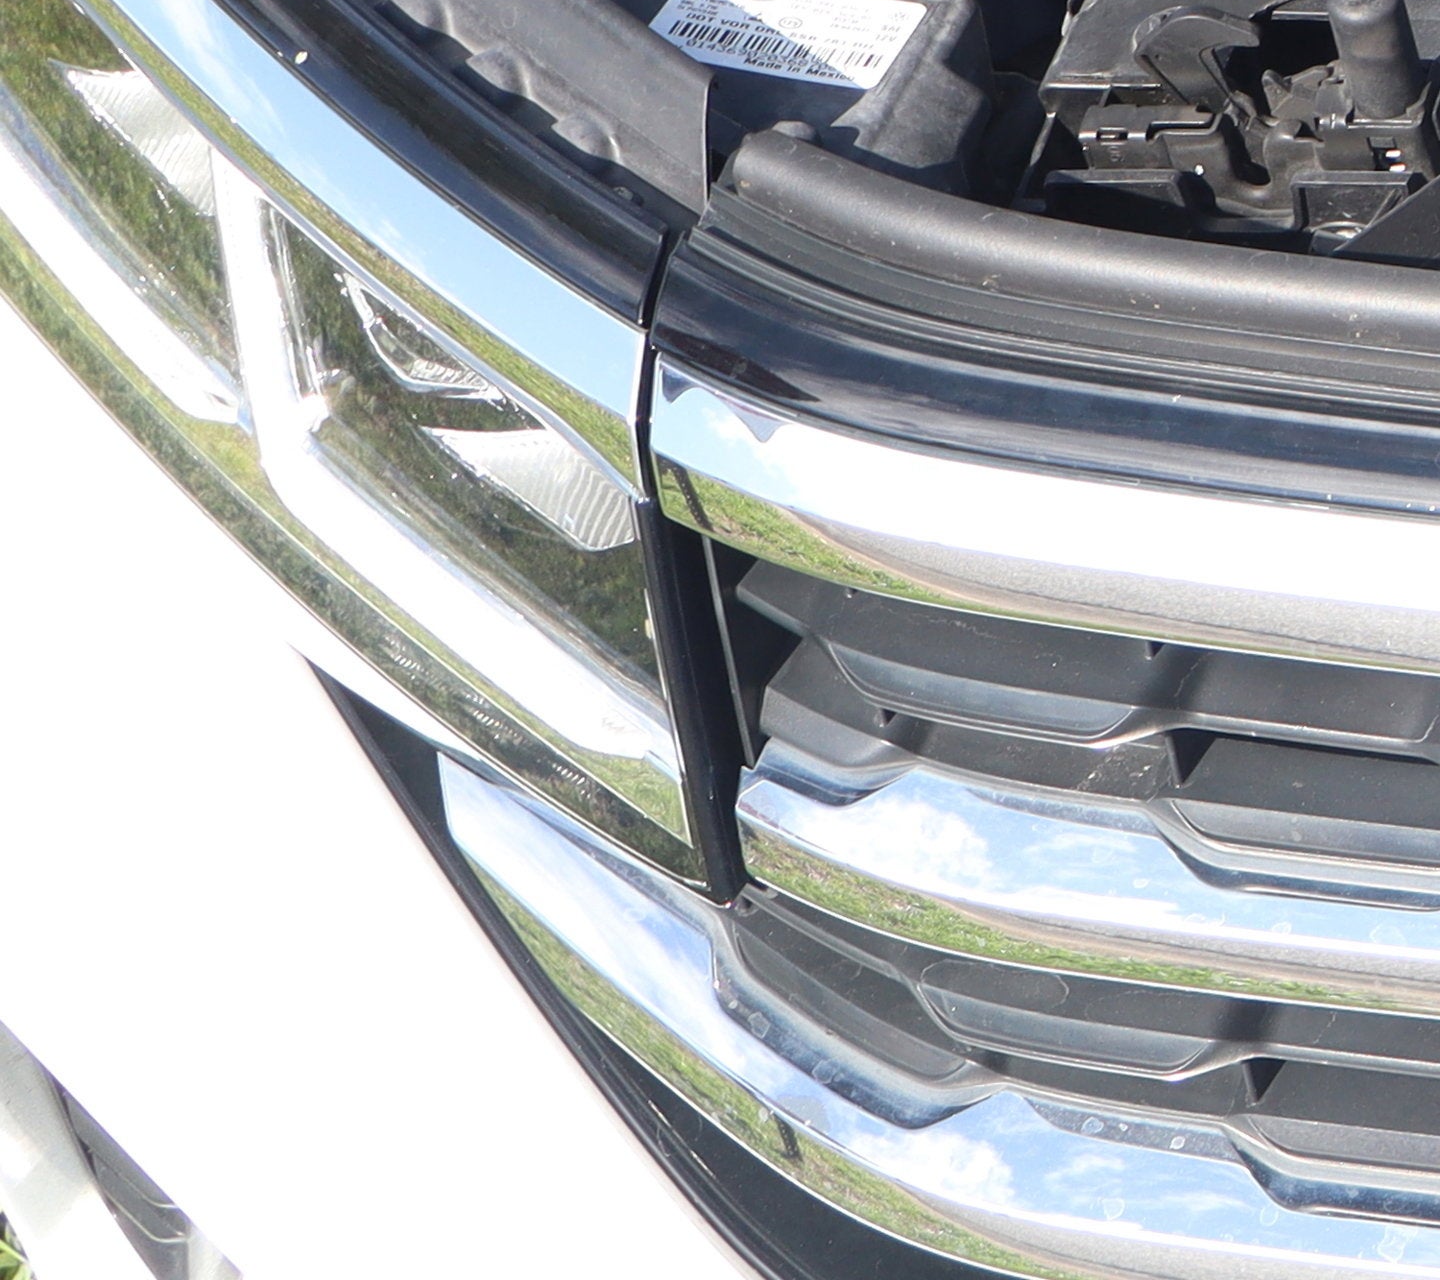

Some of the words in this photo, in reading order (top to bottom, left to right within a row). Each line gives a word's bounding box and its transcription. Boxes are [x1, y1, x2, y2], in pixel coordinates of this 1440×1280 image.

[685, 13, 716, 23] DOT
[743, 56, 783, 70] Made
[786, 64, 800, 74] in
